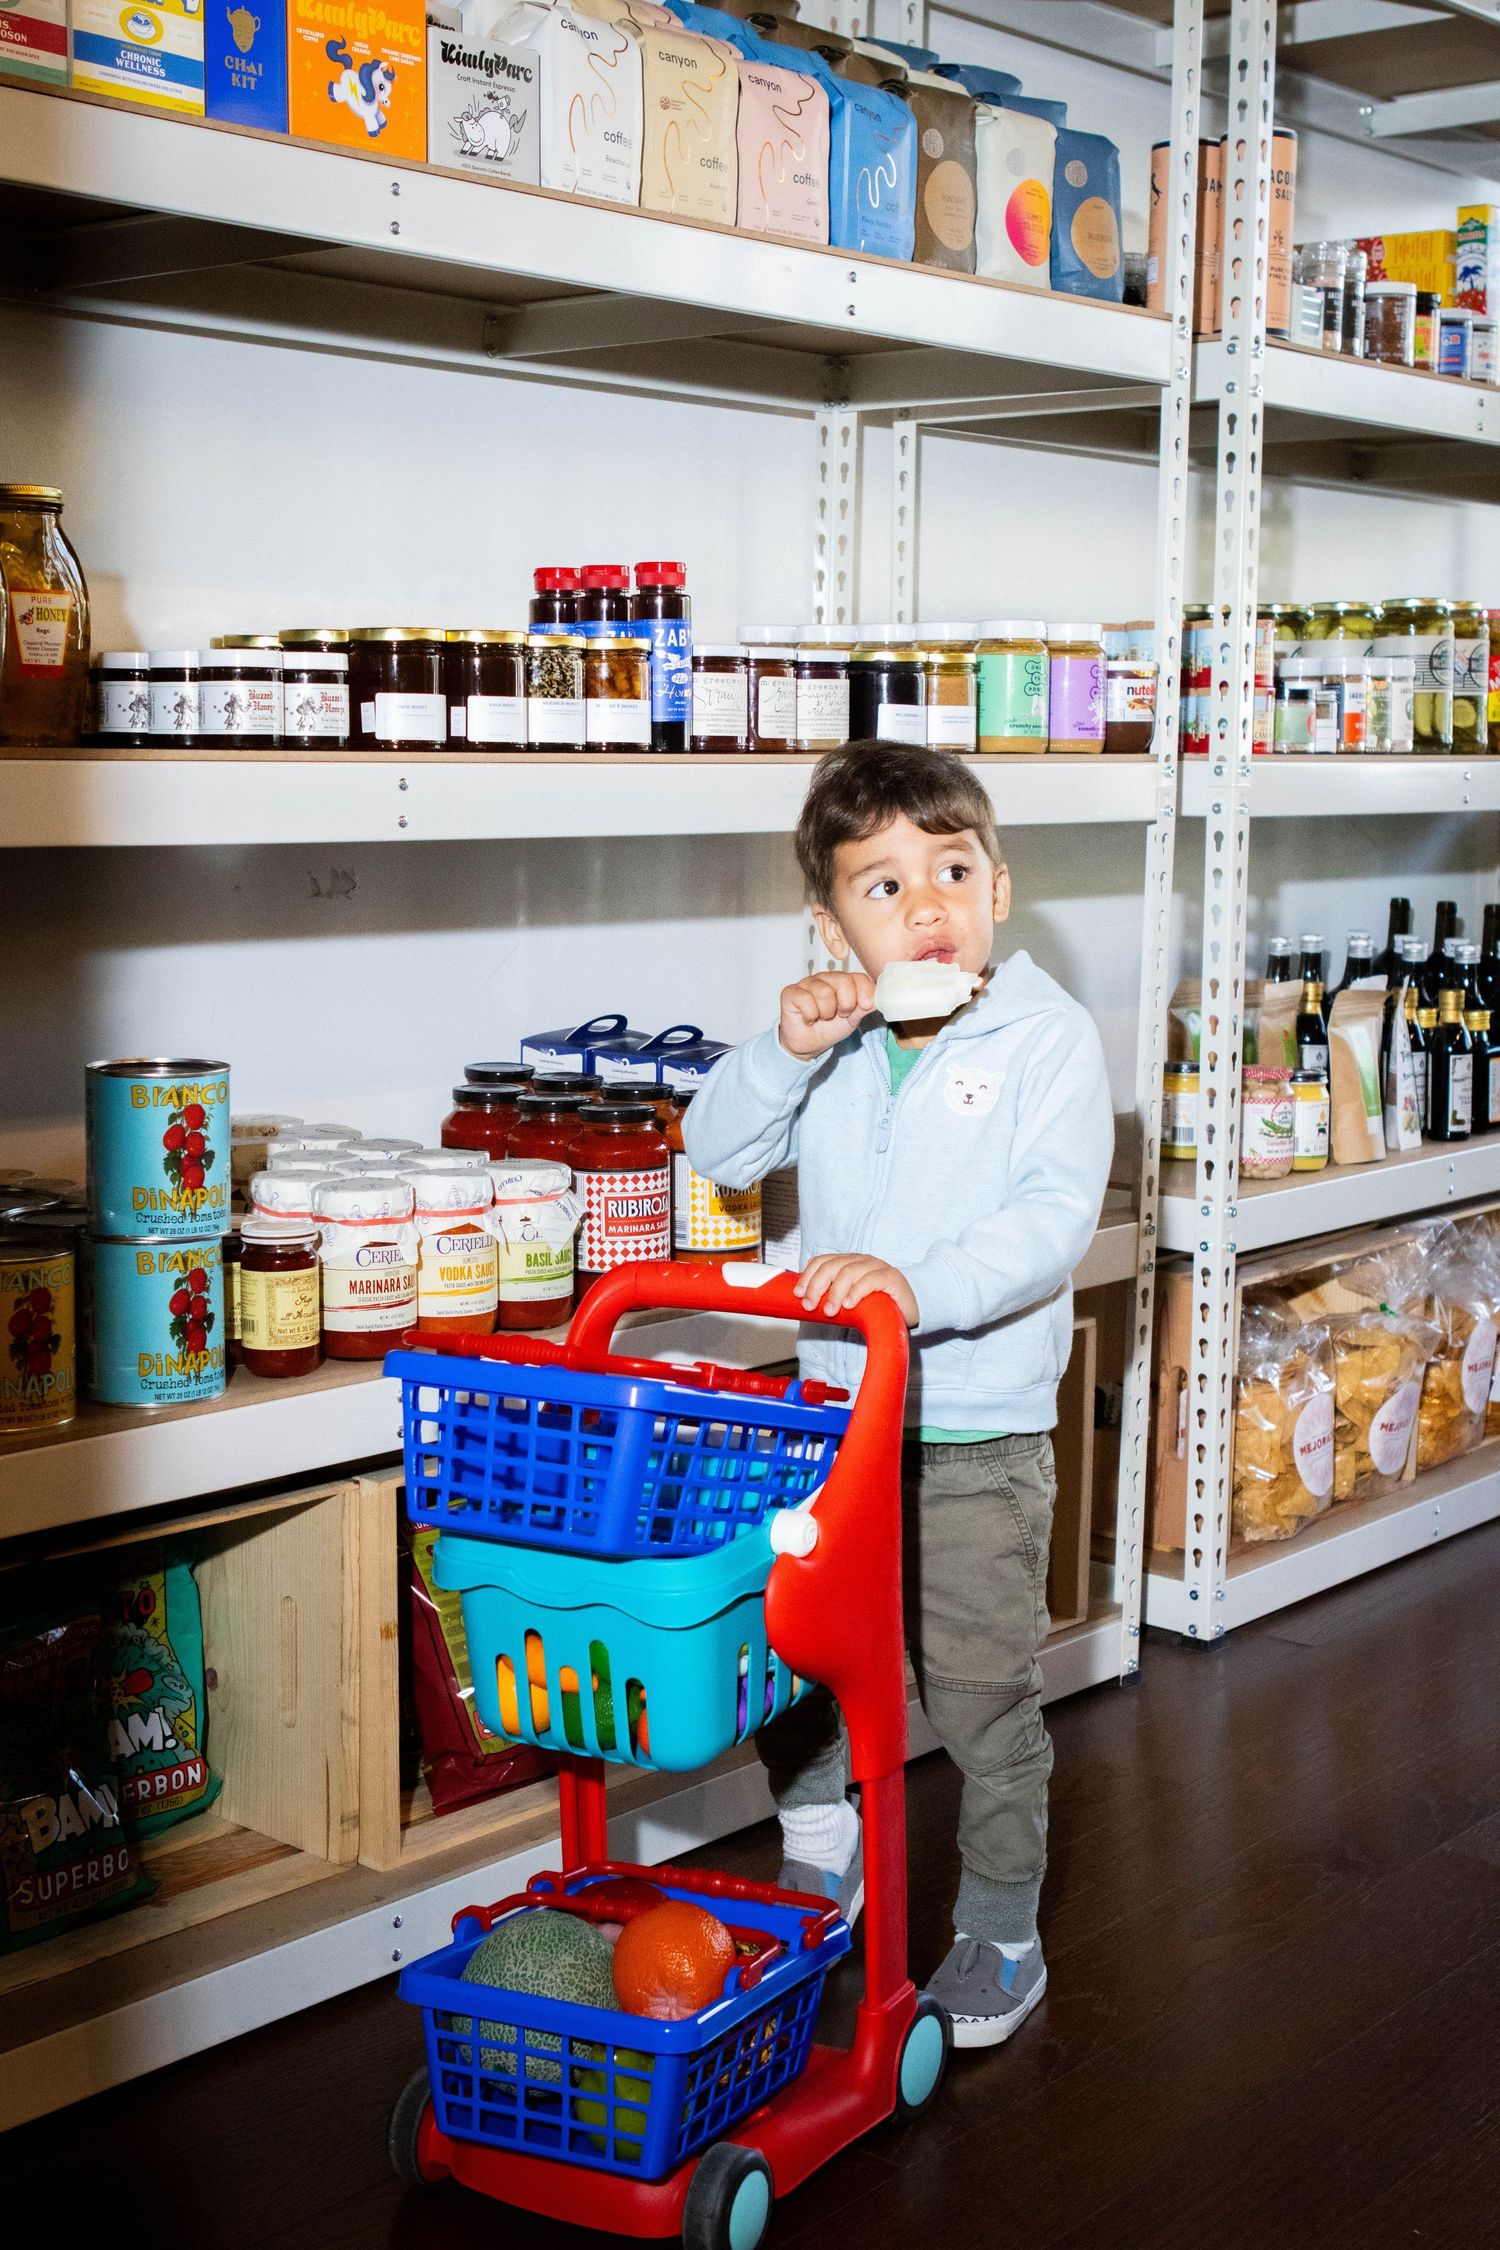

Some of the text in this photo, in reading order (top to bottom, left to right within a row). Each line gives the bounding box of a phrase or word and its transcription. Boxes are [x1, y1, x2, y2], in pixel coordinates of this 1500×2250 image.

[560, 18, 599, 41] canyon
[115, 57, 166, 78] WELLNESS
[120, 50, 162, 68] CHRONIC
[224, 55, 263, 76] CHAI
[658, 50, 698, 70] canyon
[231, 72, 258, 90] KIT
[456, 73, 516, 93] Craft Instant Espresso
[748, 74, 782, 94] canyon
[854, 102, 882, 123] canyon
[604, 130, 632, 150] coffee
[700, 156, 729, 174] coffee
[792, 172, 820, 189] coffee
[31, 596, 52, 604] PURE
[36, 607, 66, 622] HONEY
[654, 628, 692, 647] ZAB'
[130, 1080, 228, 1109] BIANCO
[719, 1204, 748, 1212] VODKA
[136, 1212, 185, 1224] Crushed
[148, 1227, 159, 1235] NET
[160, 1227, 169, 1235] WT
[169, 1226, 176, 1234] 28
[176, 1226, 185, 1234] OZ
[191, 1226, 198, 1234] LB
[608, 1224, 655, 1234] MARINARA
[356, 1248, 404, 1268] CERIE
[526, 1252, 552, 1268] BASIL
[439, 1264, 472, 1282] VODKA
[349, 1278, 400, 1294] MARINARA
[140, 1378, 190, 1390] Crushed
[154, 1392, 166, 1400] NET
[166, 1392, 176, 1400] WT
[18, 1848, 129, 1905] SUPERBO
